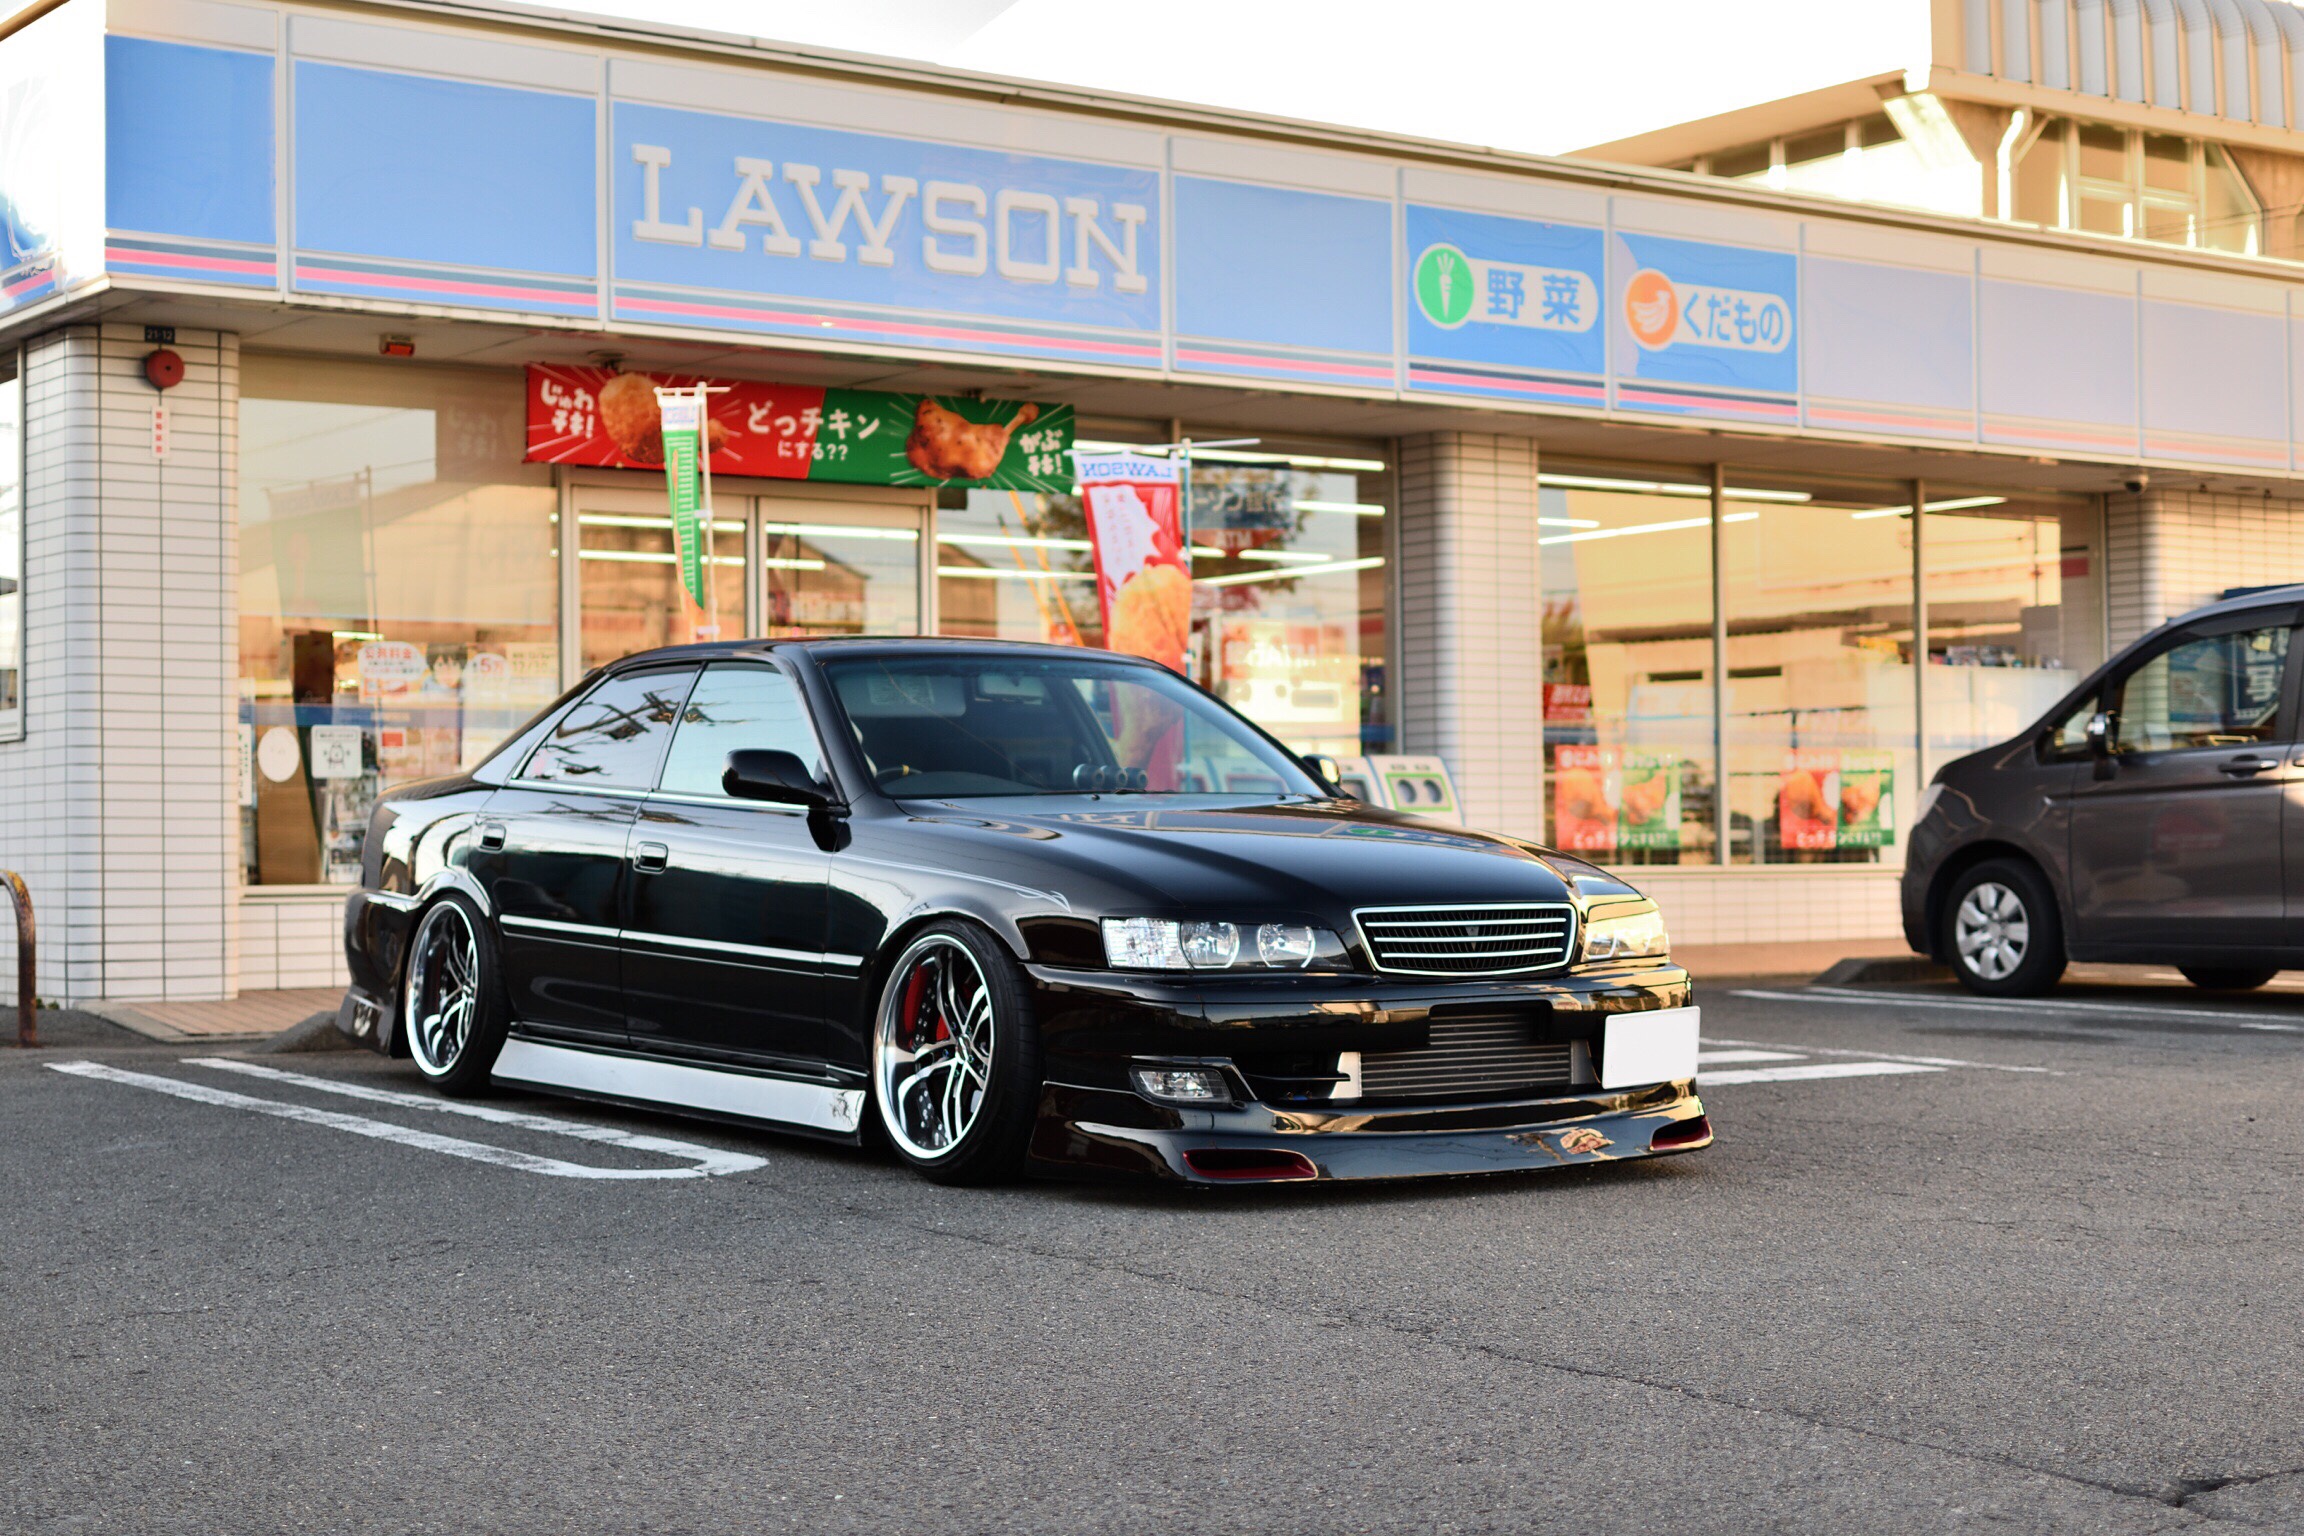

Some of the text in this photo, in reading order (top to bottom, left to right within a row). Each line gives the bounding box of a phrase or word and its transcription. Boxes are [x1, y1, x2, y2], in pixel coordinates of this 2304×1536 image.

[632, 144, 1147, 292] LAWSON
[1486, 267, 1582, 327] 野菜
[1682, 292, 1785, 347] くだもの
[747, 400, 881, 440] どっチキン
[777, 439, 849, 461] にする??
